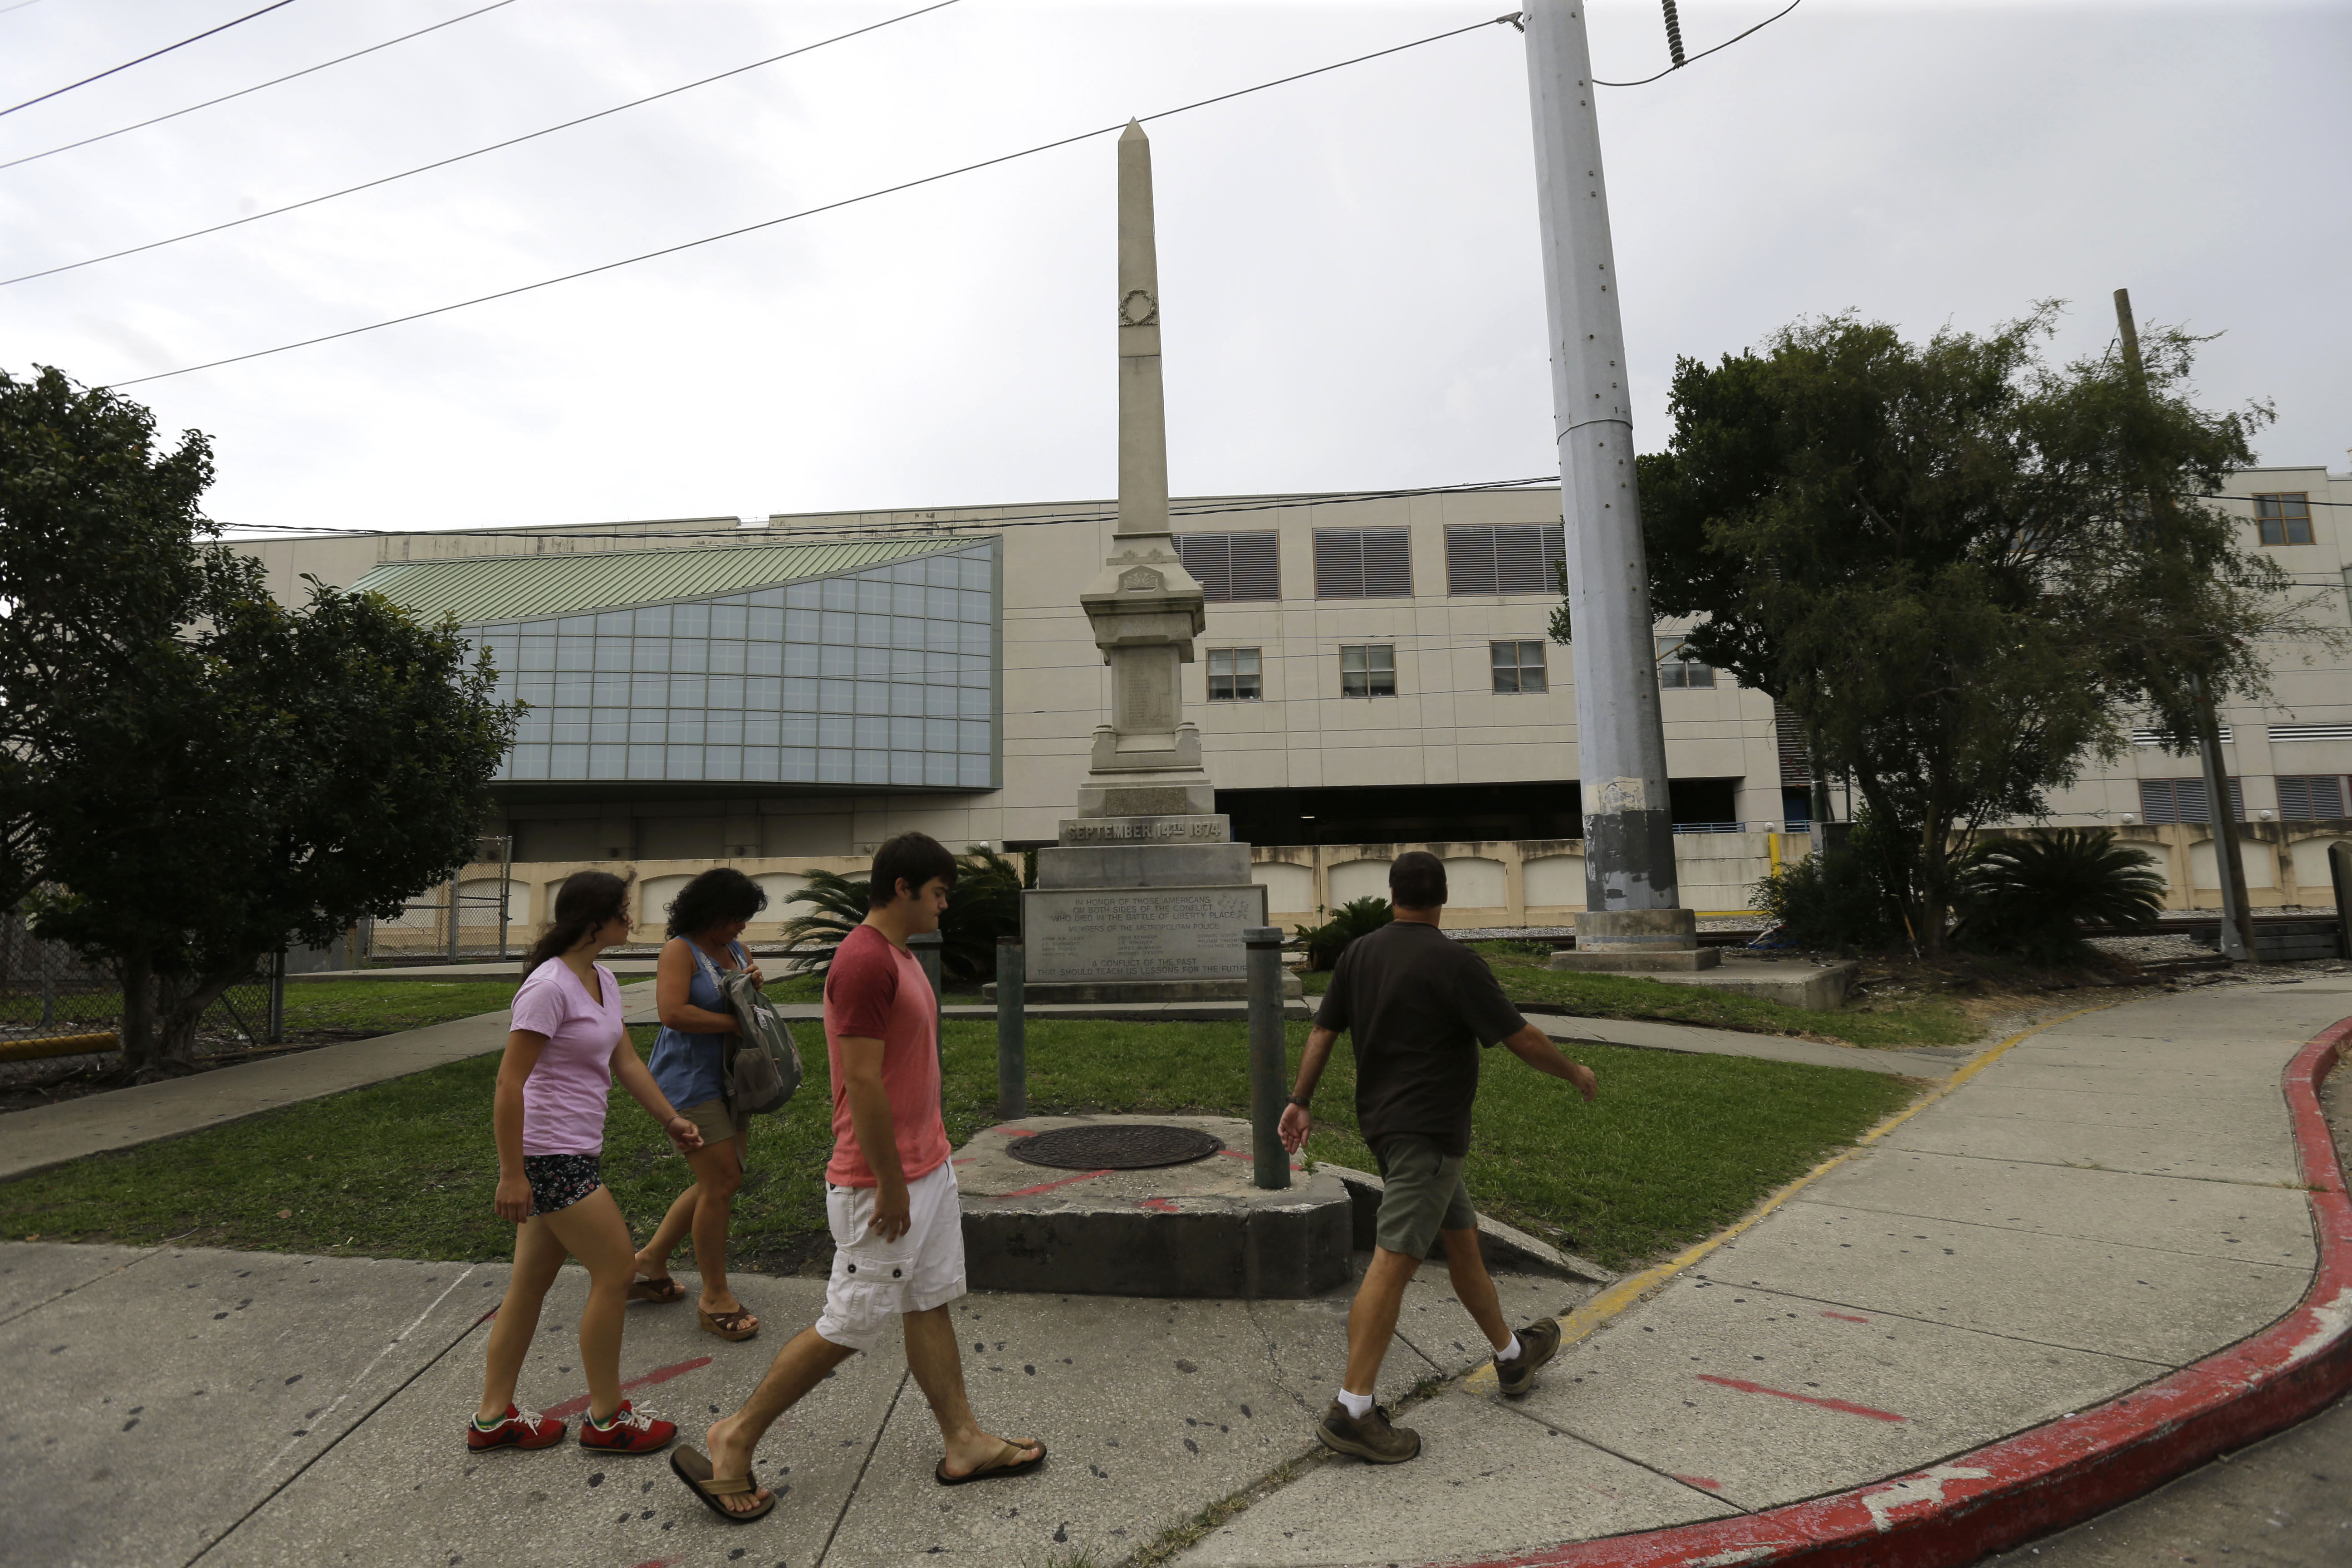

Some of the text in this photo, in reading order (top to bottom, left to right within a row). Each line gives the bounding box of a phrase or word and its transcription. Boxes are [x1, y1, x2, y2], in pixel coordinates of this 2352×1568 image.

[1068, 822, 1220, 840] SEPTEMBER 14TH 1874
[1163, 896, 1210, 904] AMERICANS
[1173, 904, 1213, 912] CONFLICT
[1060, 968, 1093, 976] SHOULD
[1221, 965, 1247, 973] FUTUR
